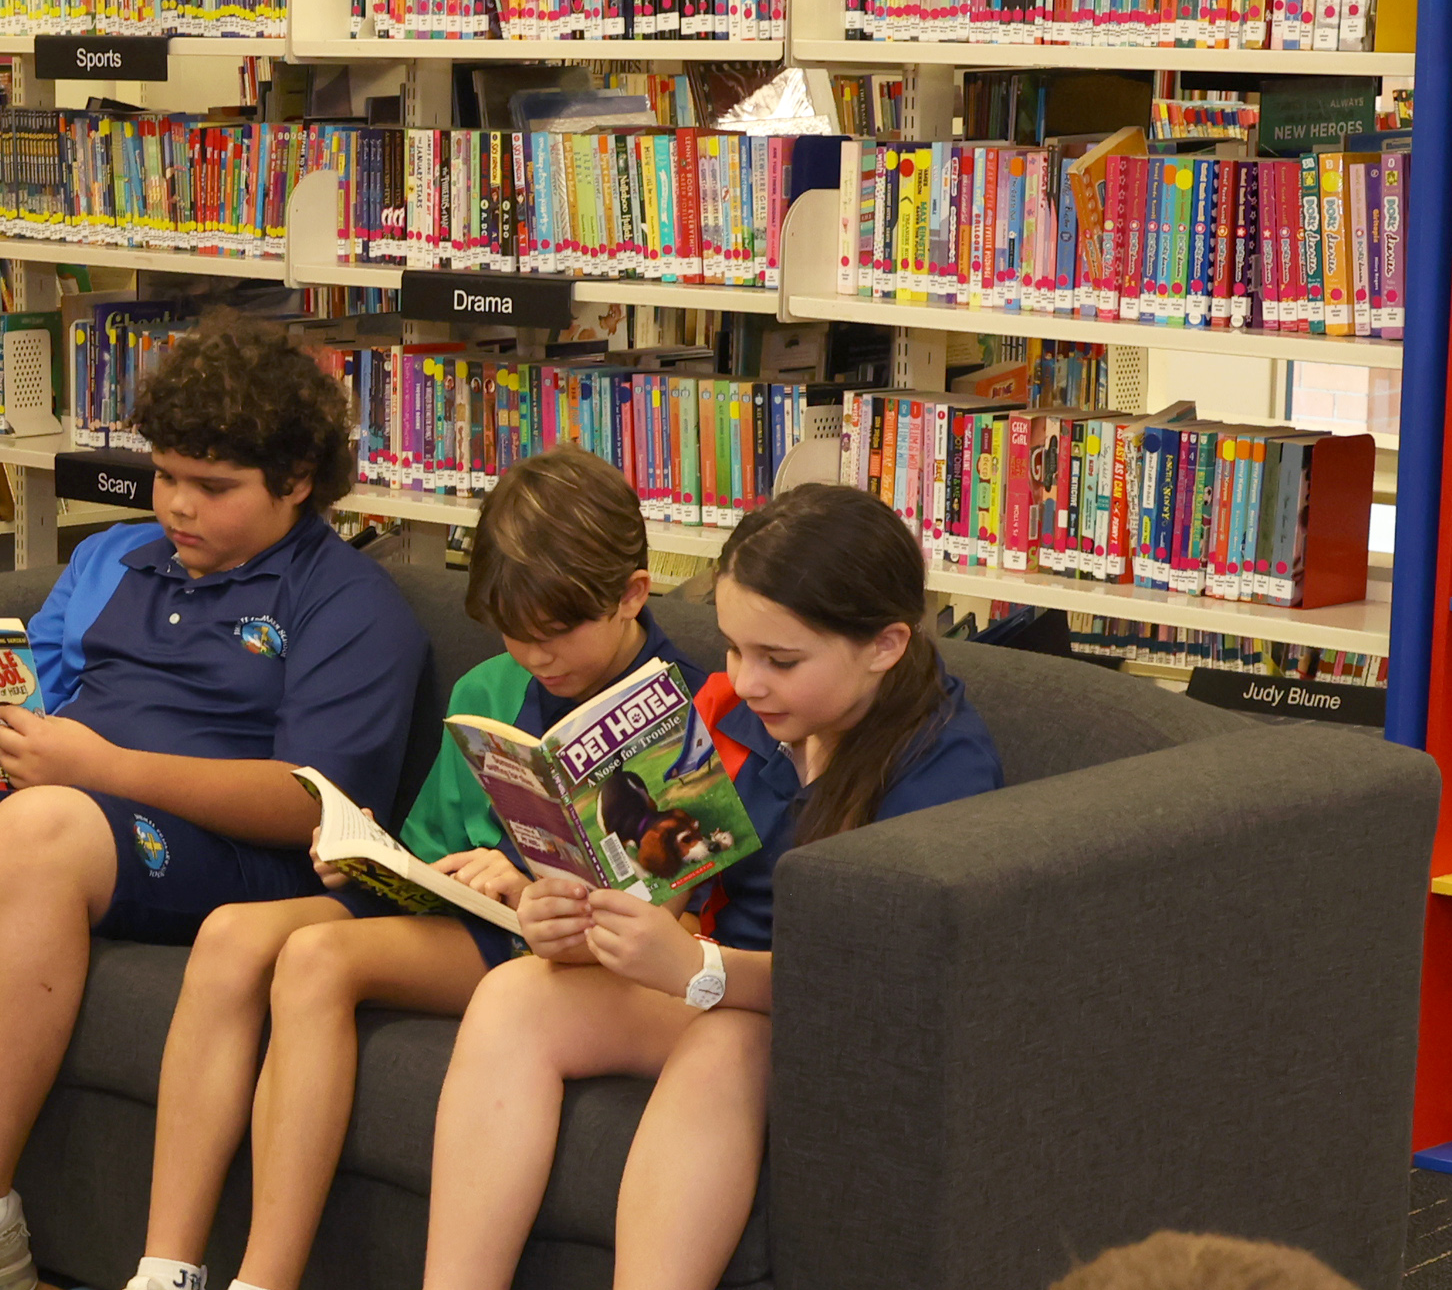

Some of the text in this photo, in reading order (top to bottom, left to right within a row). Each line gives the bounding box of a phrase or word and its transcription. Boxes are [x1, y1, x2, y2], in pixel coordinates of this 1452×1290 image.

[76, 48, 122, 71] Sports
[1330, 97, 1364, 108] ALWAYS
[1275, 120, 1364, 141] NEW HEROES
[415, 145, 424, 209] JANUARY STARS
[758, 195, 766, 221] GIRLS
[1306, 233, 1318, 274] diaries
[1326, 233, 1337, 274] diaries
[1383, 233, 1397, 277] diaries
[453, 289, 513, 314] Drama
[1011, 421, 1029, 434] GEEK
[1011, 433, 1029, 446] GIRL
[97, 471, 137, 499] Scary
[1243, 682, 1342, 710] Judy Blume
[565, 728, 606, 774] PET
[605, 680, 679, 743] HOTEL
[587, 713, 682, 789] A Nose for Trouble
